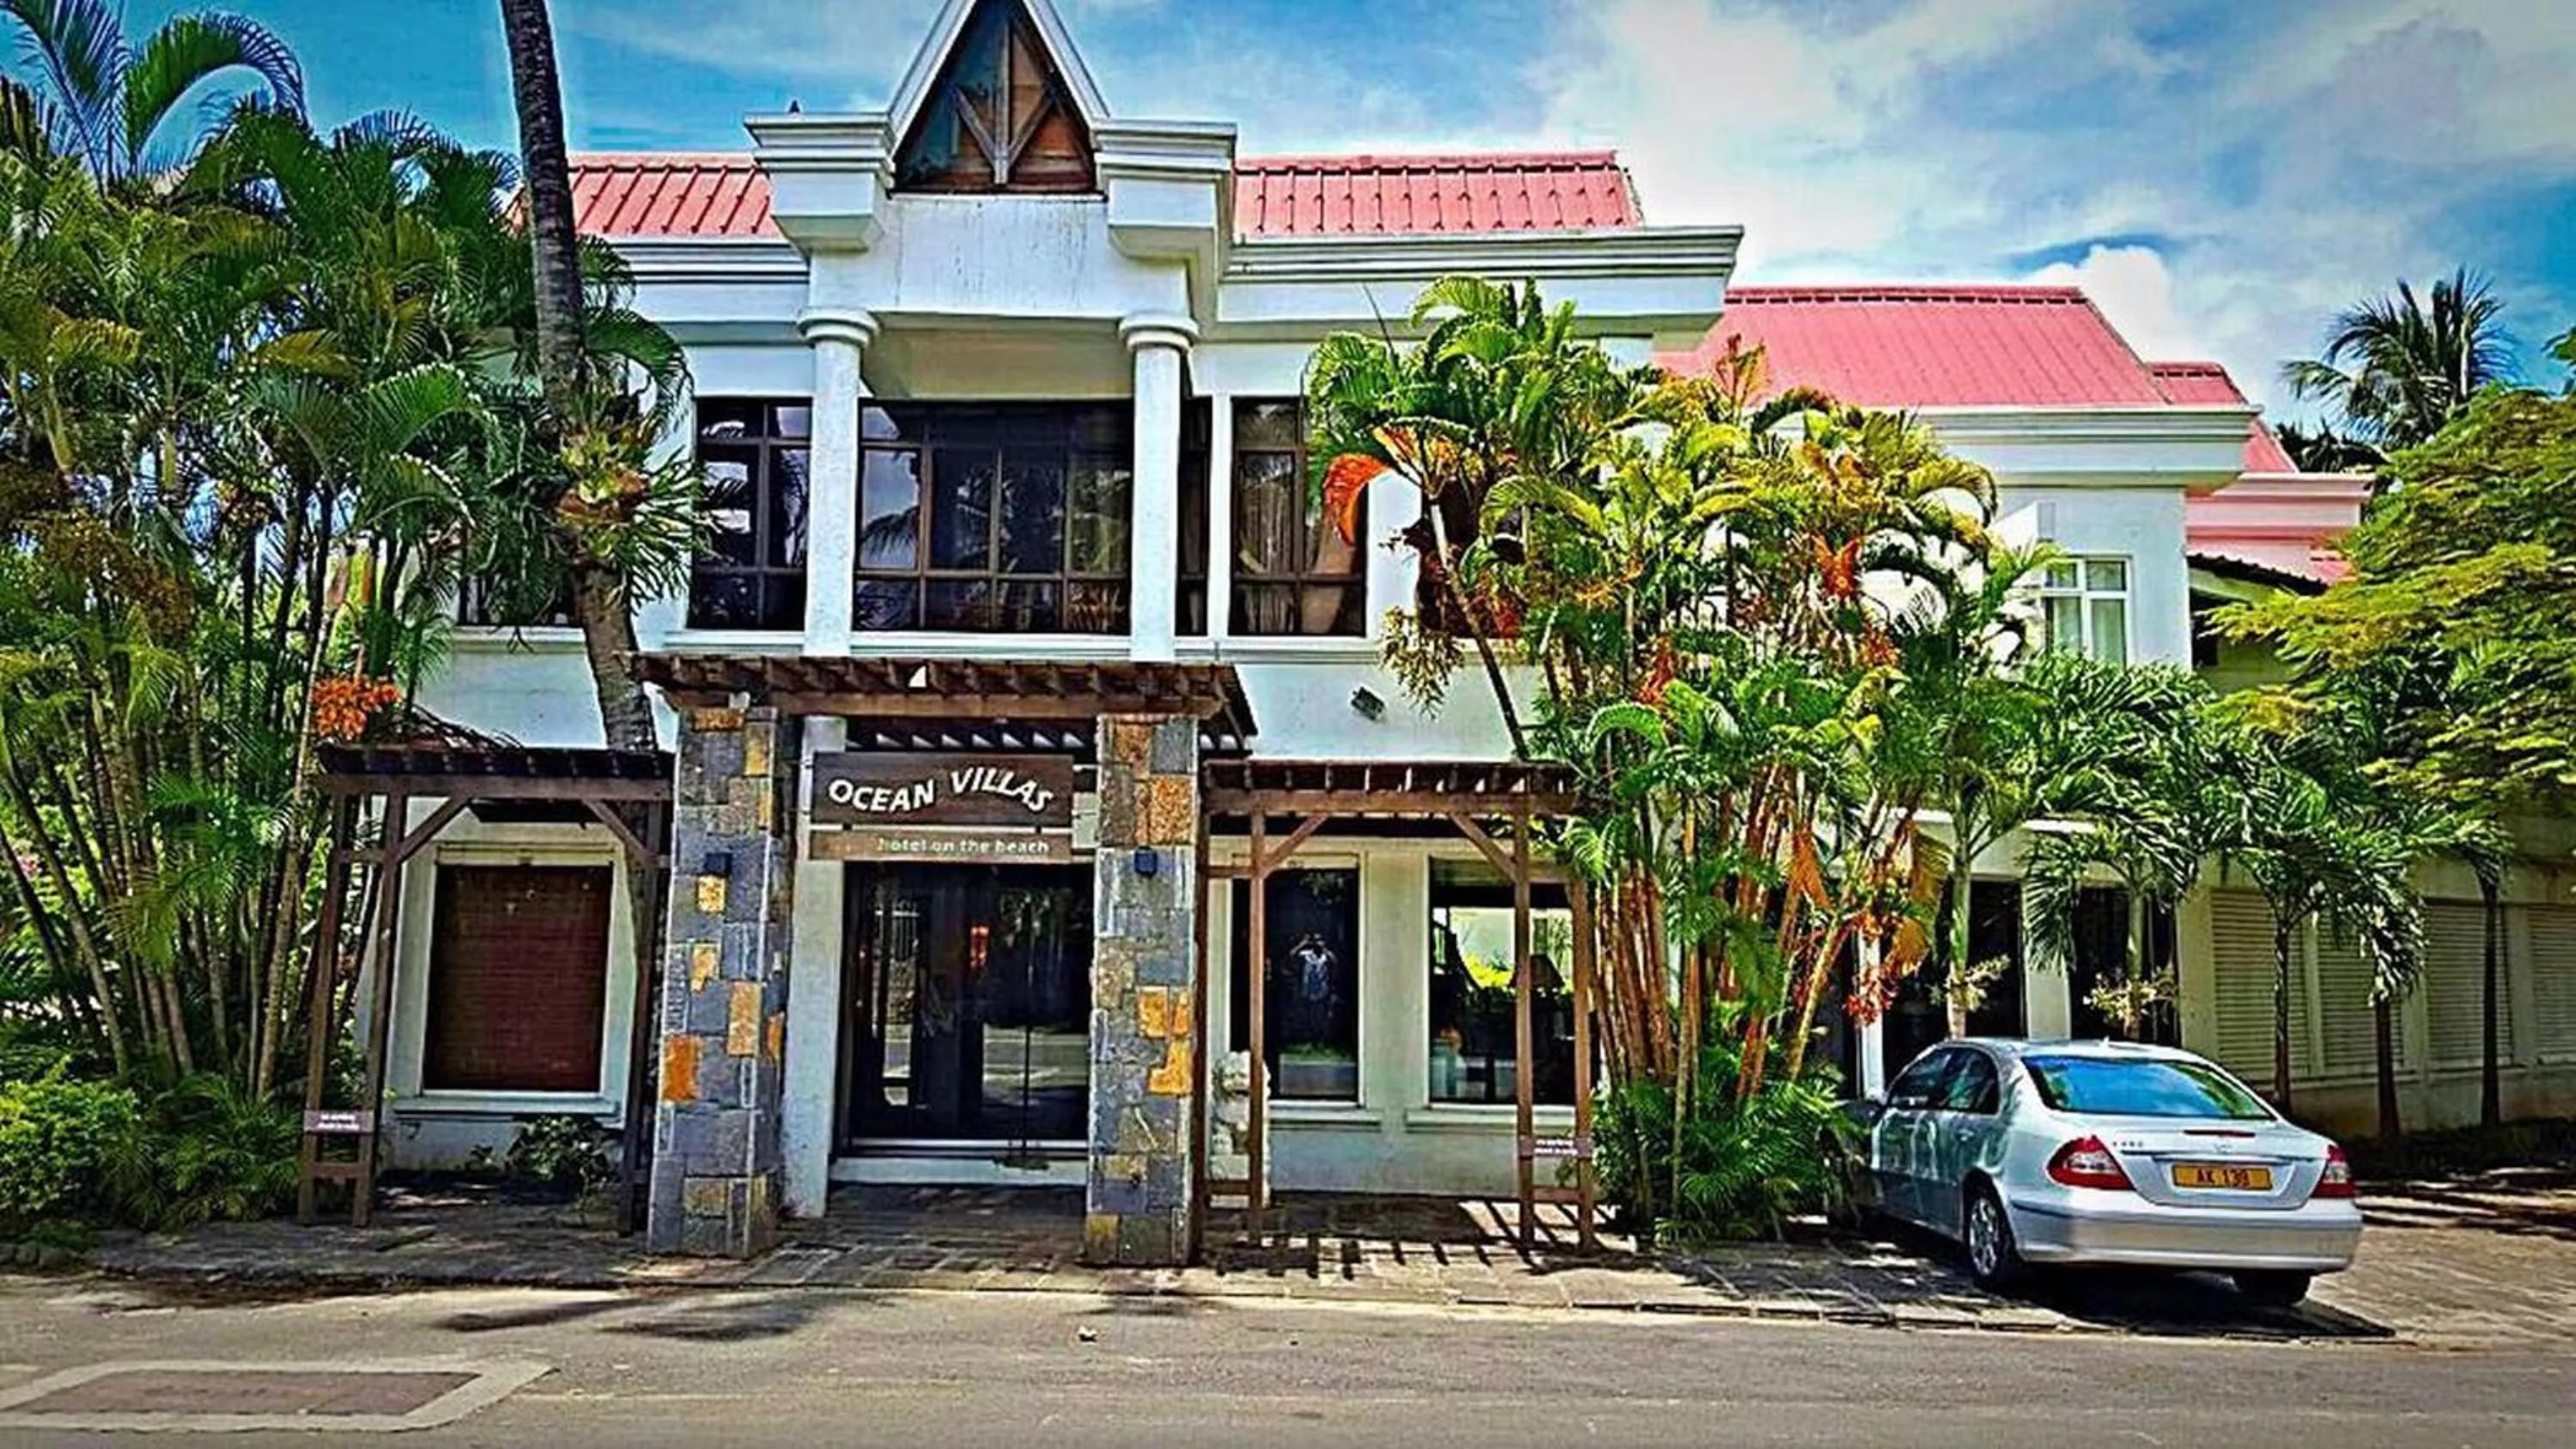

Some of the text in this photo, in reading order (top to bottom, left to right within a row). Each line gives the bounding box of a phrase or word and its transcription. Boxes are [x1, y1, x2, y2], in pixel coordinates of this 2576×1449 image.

[828, 767, 1054, 811] OCEAN VILLAS
[877, 837, 1049, 853] hotel on the beach
